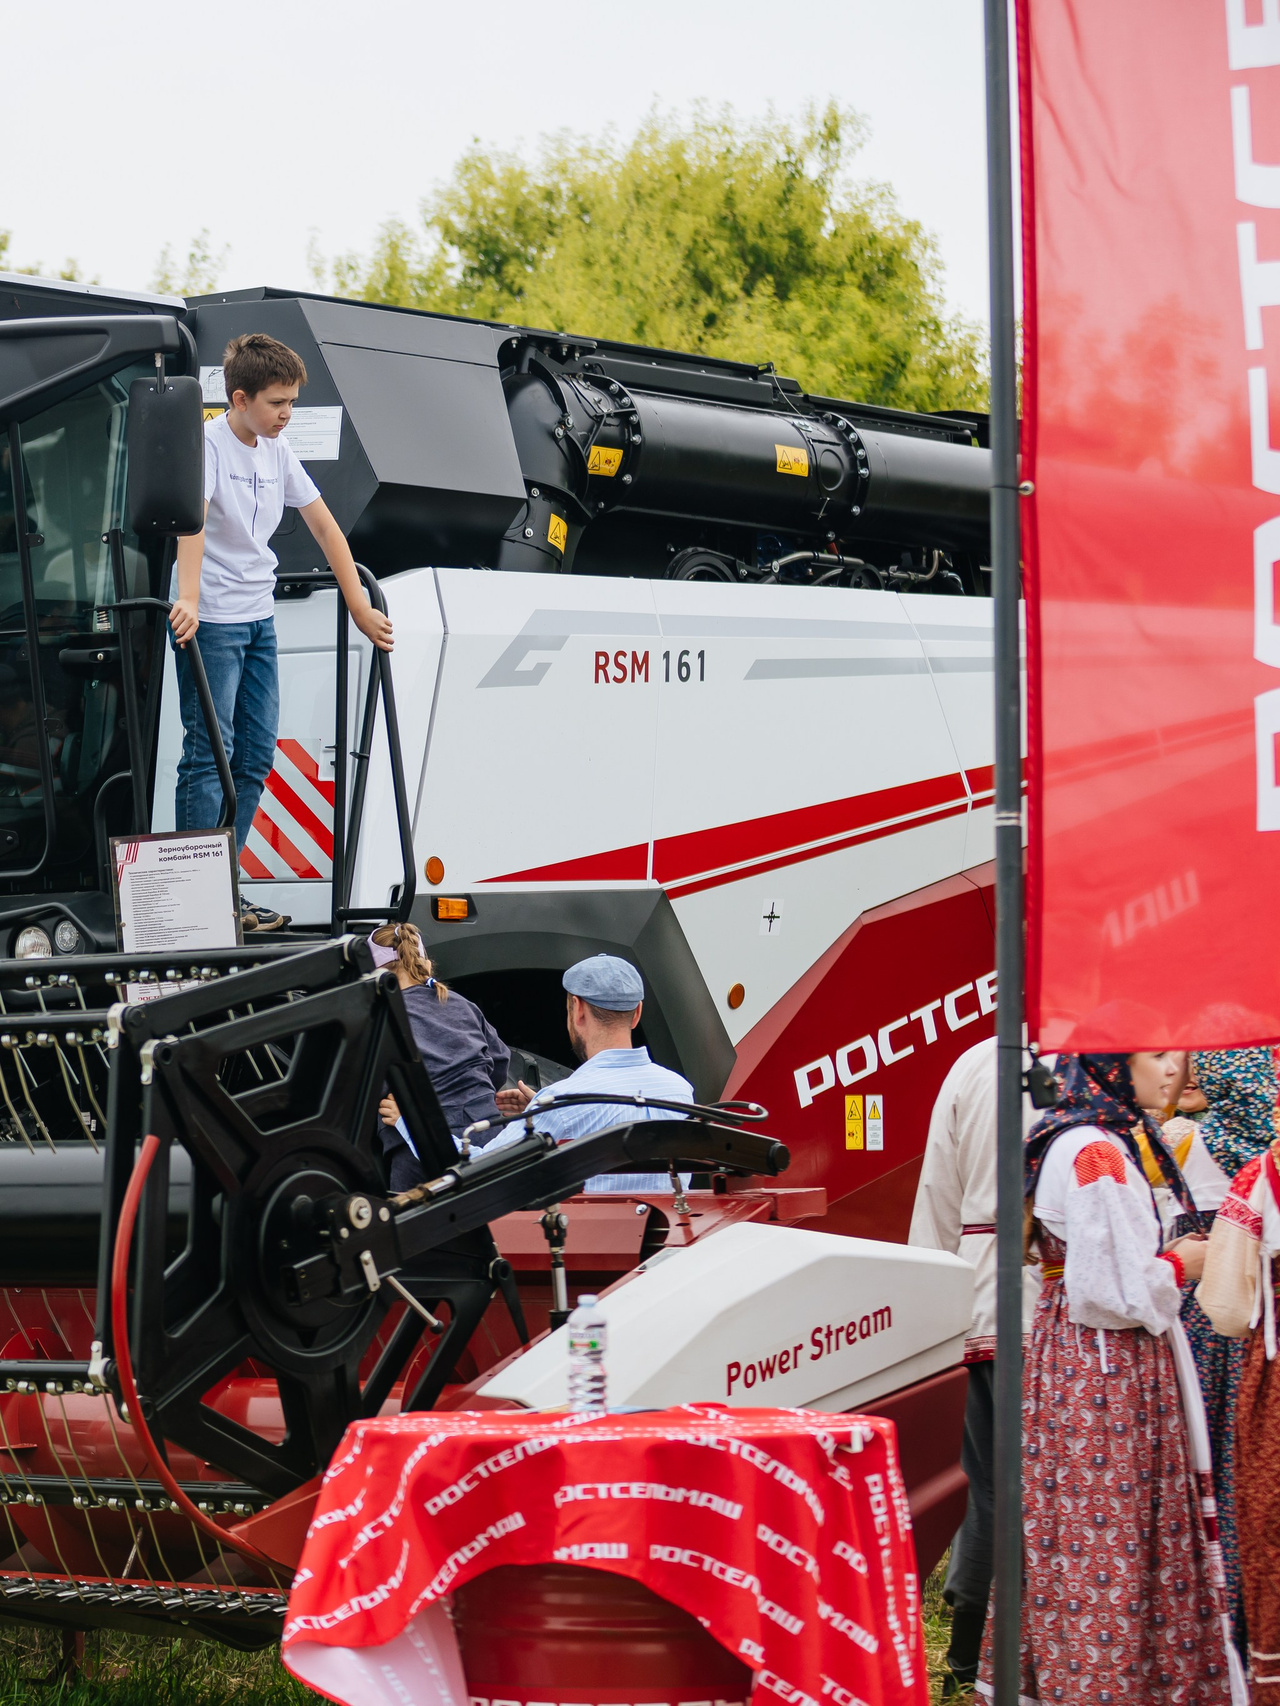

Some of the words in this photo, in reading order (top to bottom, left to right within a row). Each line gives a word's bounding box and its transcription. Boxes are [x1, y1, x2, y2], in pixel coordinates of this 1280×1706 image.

[594, 649, 651, 685] RSM
[661, 648, 706, 684] 161
[157, 841, 223, 854] Зерноуборочный
[158, 853, 192, 863] комбайн
[192, 851, 210, 860] RSM
[211, 850, 223, 858] 161
[726, 1342, 804, 1397] Power
[809, 1304, 893, 1362] Stream
